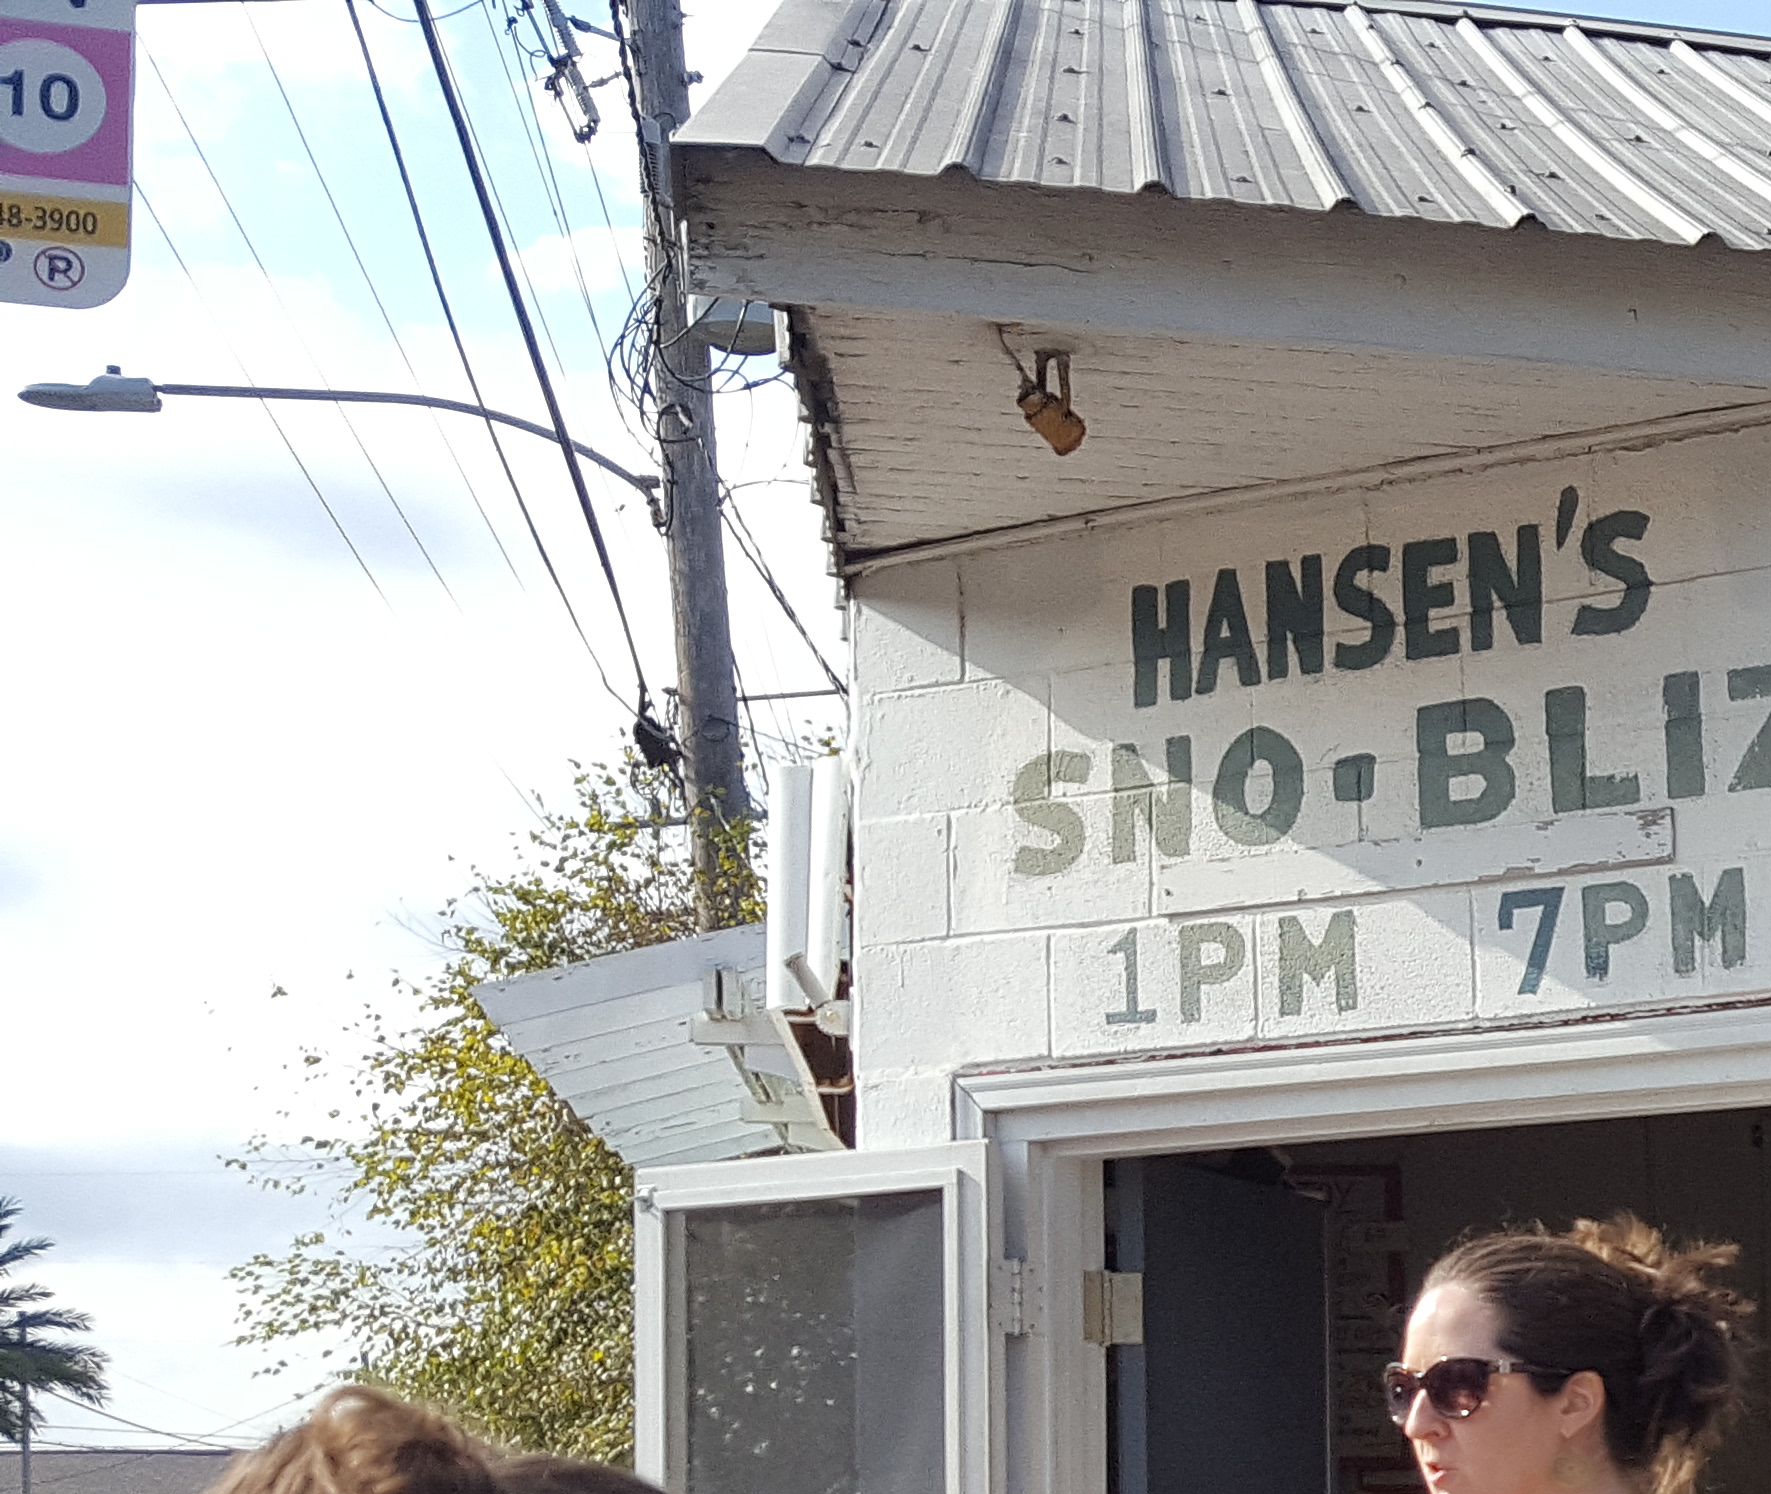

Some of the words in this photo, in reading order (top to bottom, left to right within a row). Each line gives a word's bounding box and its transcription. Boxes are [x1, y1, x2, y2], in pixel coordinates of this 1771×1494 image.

[1130, 484, 1654, 709] HANSEN'S
[1103, 906, 1358, 1029] 1PM
[1496, 865, 1747, 996] 7PM
